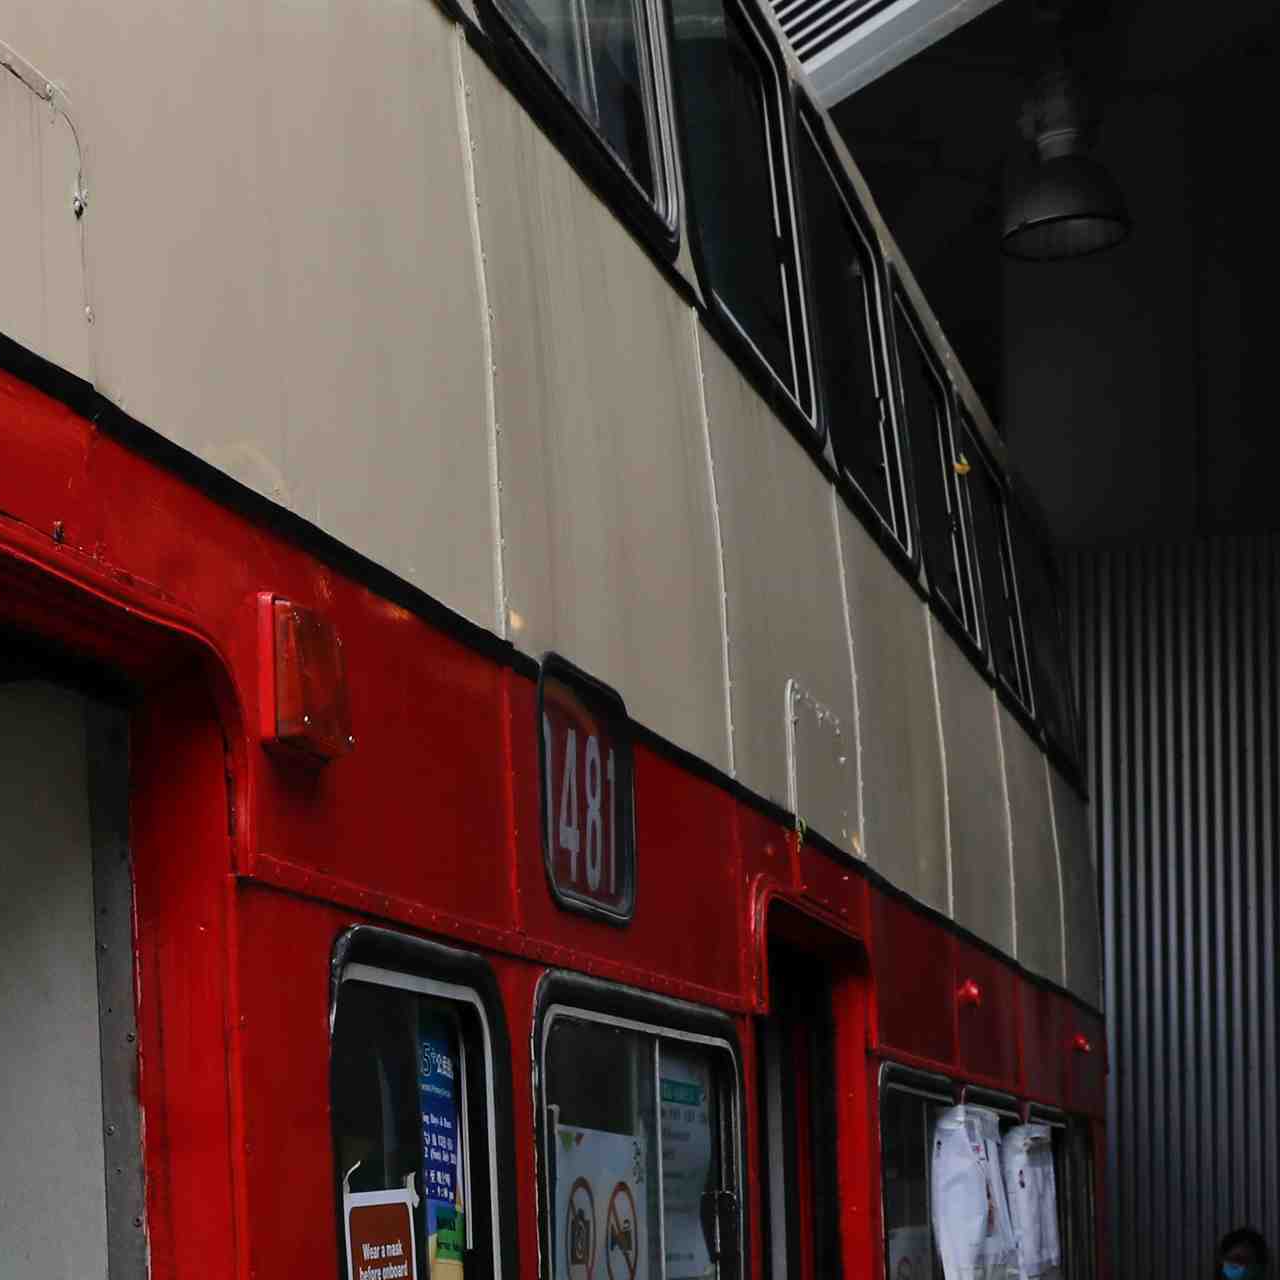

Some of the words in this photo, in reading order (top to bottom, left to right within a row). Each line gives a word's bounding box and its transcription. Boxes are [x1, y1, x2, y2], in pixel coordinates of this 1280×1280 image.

[542, 711, 616, 895] 481
[362, 1243, 380, 1260] Wear
[386, 1239, 404, 1258] mask
[382, 1259, 409, 1280] onboard
